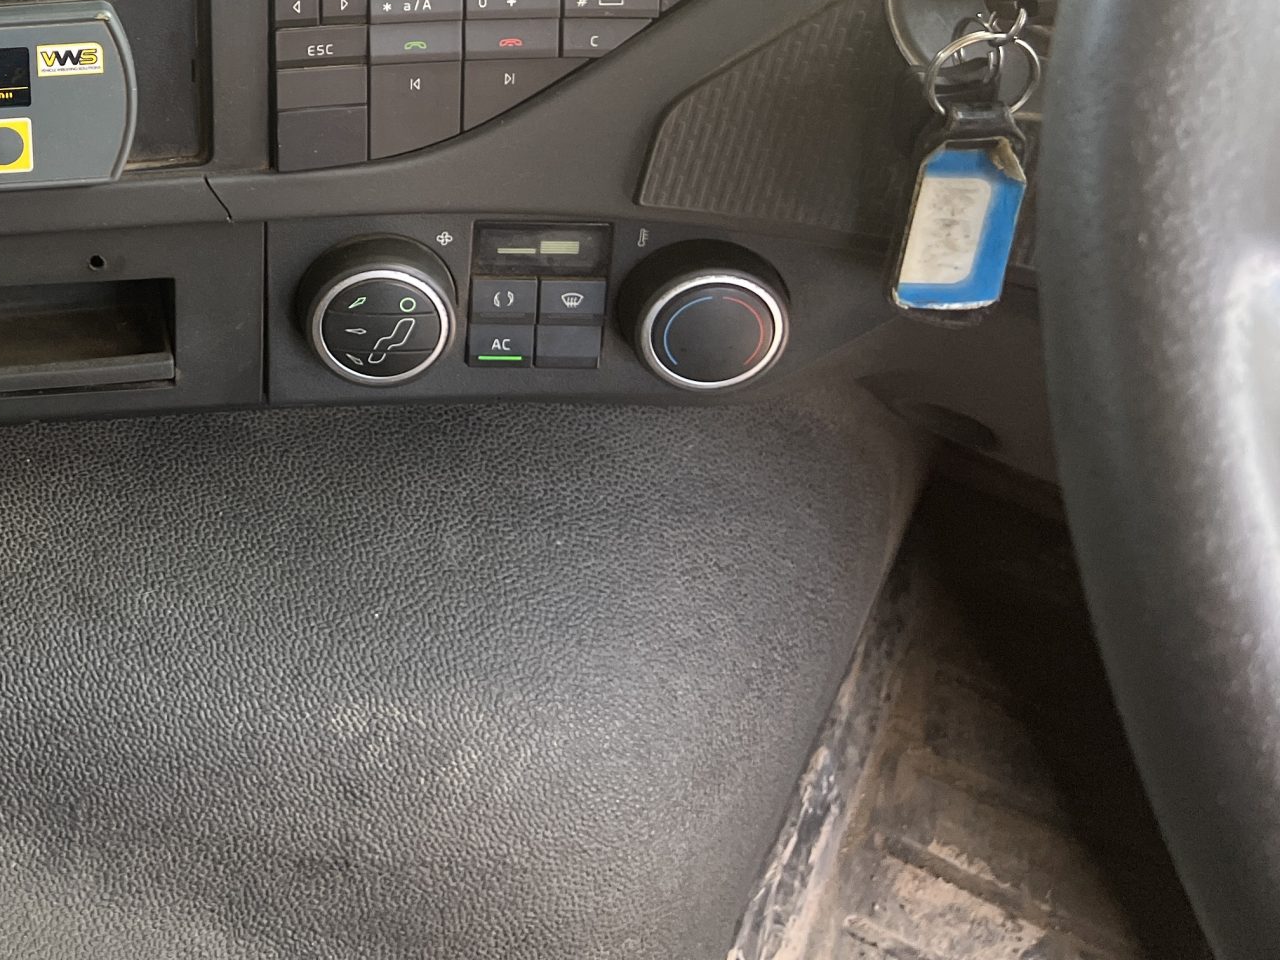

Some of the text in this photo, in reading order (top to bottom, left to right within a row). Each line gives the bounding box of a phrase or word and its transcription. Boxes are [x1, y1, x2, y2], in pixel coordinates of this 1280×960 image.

[404, 0, 431, 11] a/A
[591, 36, 598, 46] C
[308, 44, 333, 56] ESC
[492, 339, 510, 350] AC
